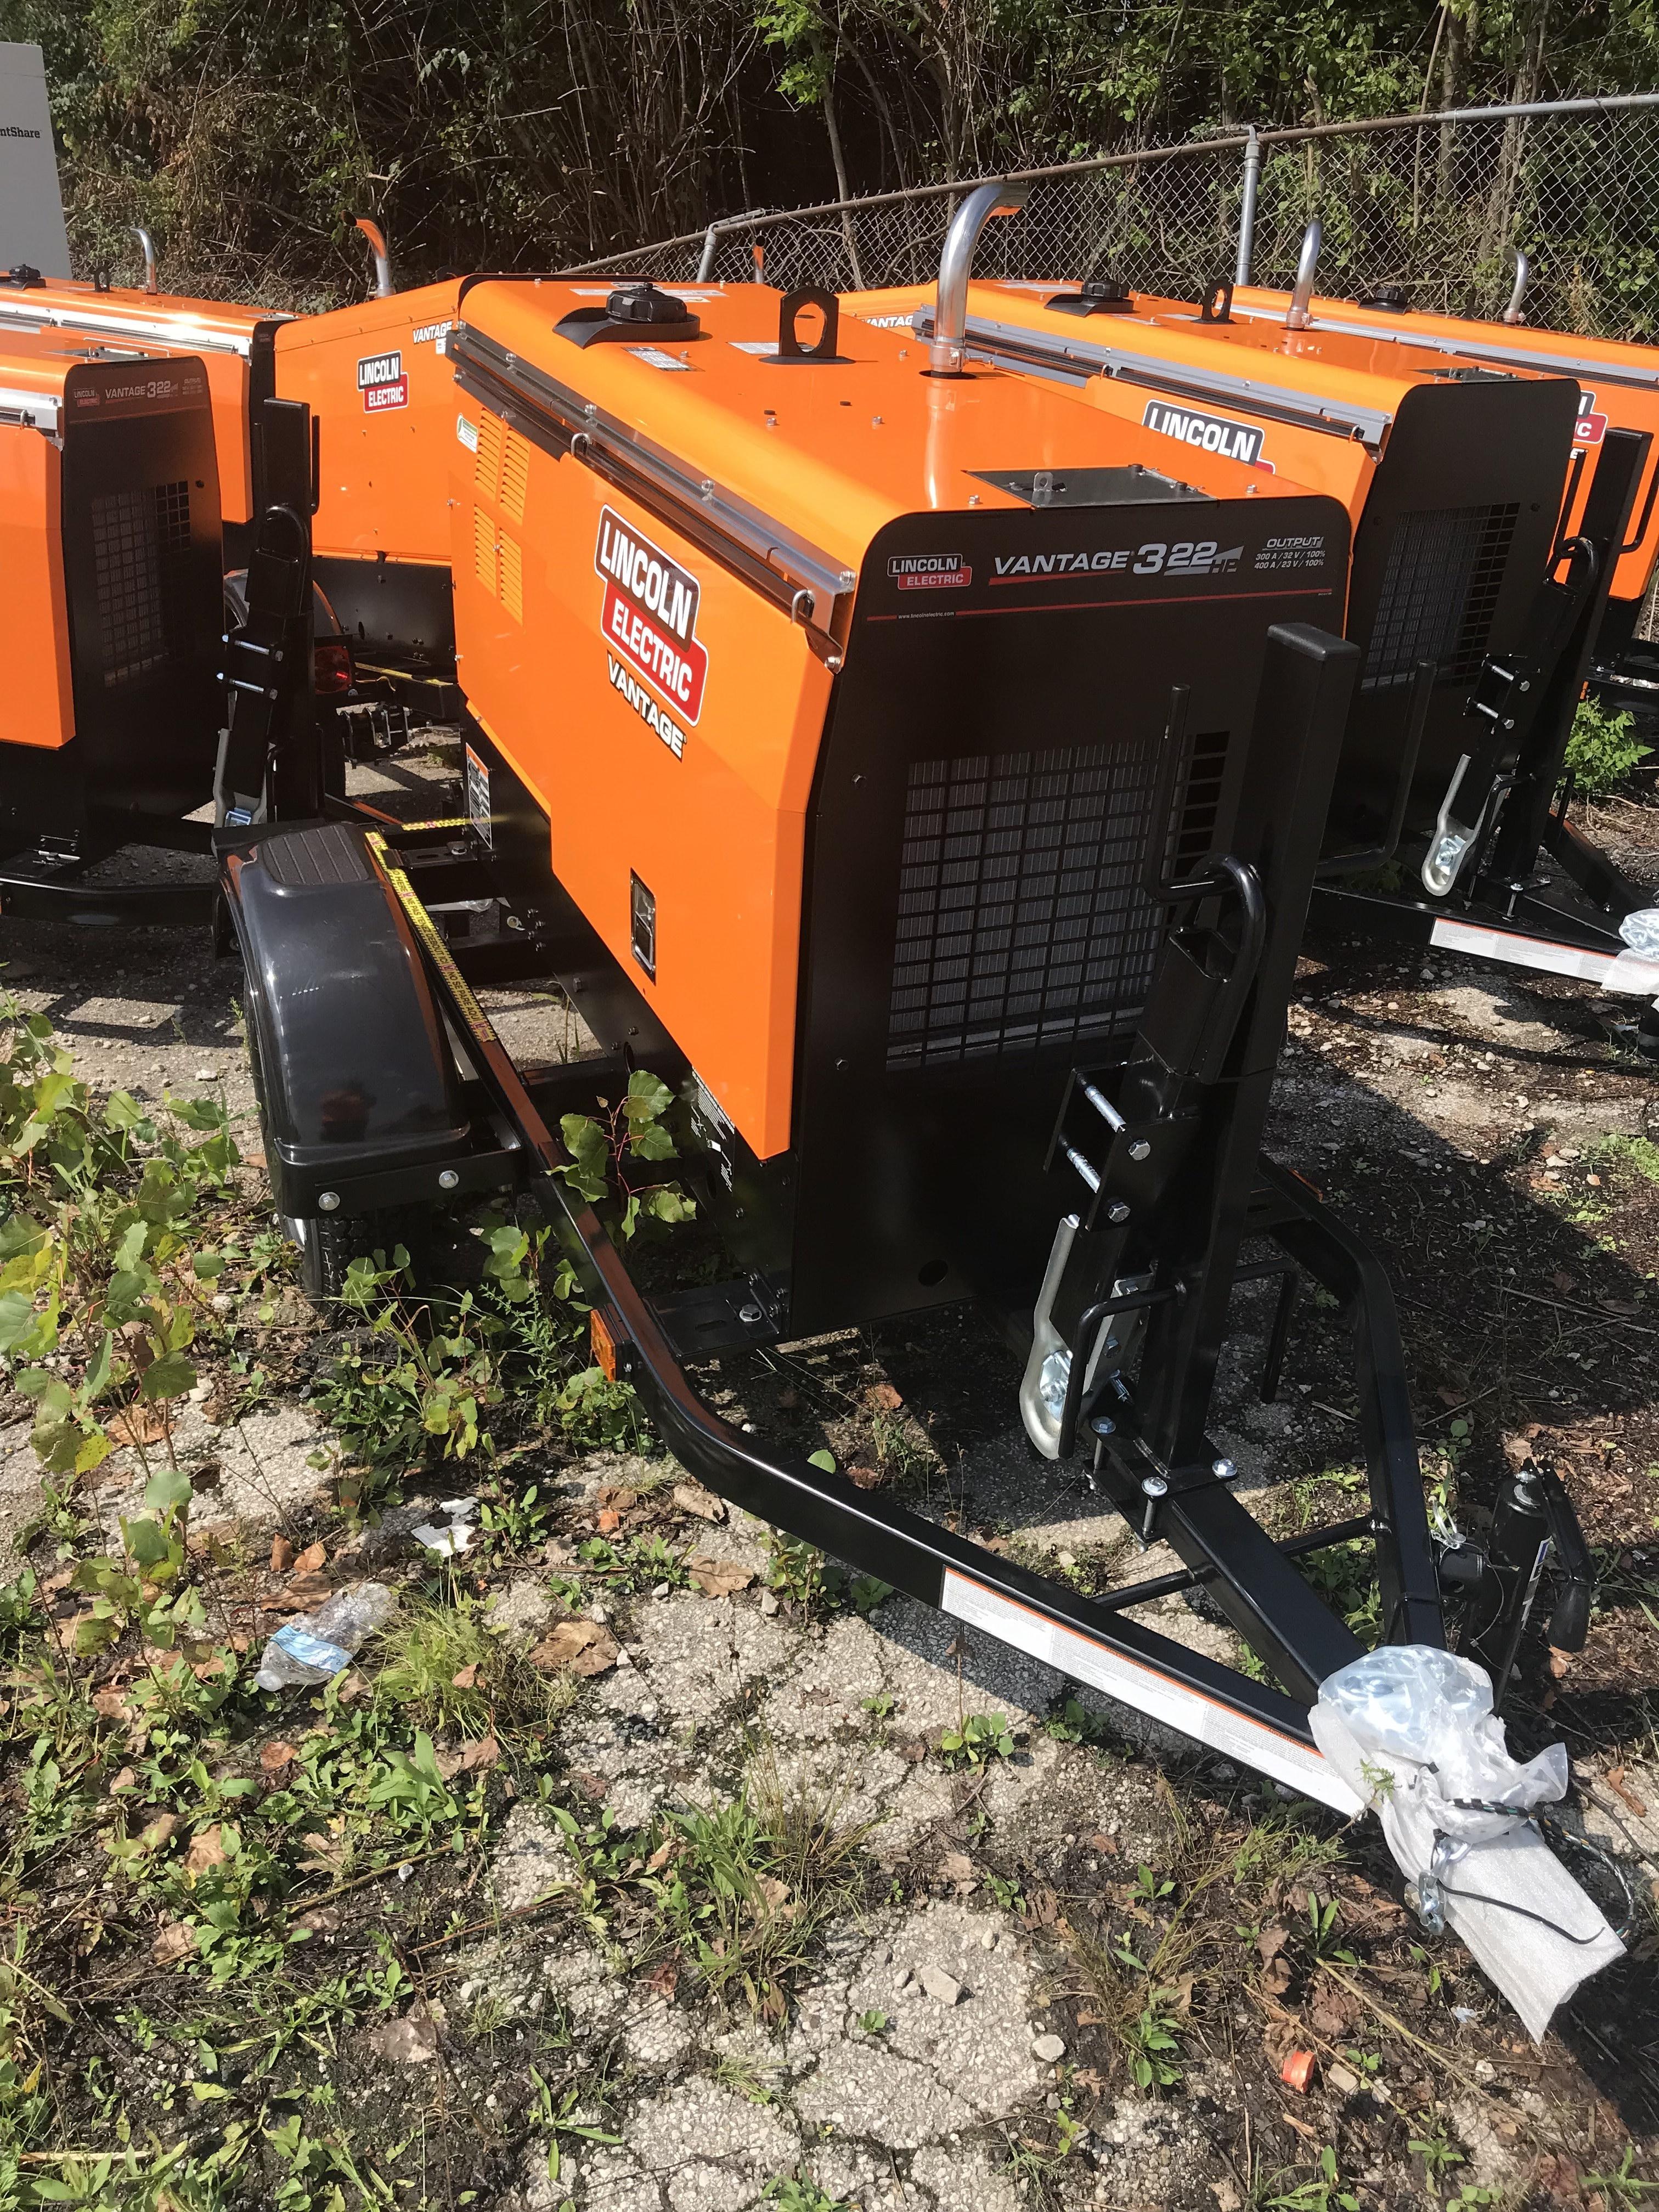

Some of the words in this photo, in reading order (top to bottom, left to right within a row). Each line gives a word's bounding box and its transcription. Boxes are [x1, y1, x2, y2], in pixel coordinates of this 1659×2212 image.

[0, 126, 41, 138] ntShare
[359, 357, 399, 386] LINCOLN
[105, 385, 146, 399] VANTAGE
[147, 380, 171, 398] 322
[368, 386, 404, 407] ELECTRIC
[1149, 408, 1256, 462] LINCOLN
[1266, 537, 1321, 548] OUTPUT
[892, 557, 958, 573] LINCOLN
[994, 551, 1131, 575] VANTAGE
[1132, 541, 1218, 574] 322
[1281, 560, 1291, 568] 23
[1305, 558, 1324, 567] 100%
[600, 520, 692, 640] LINCOLN
[906, 574, 964, 587] ELECTRIC
[611, 598, 692, 702] ELECTRIC
[607, 652, 685, 760] VANTAGE
[394, 876, 408, 892] HERE
[407, 898, 415, 907] NE
[411, 905, 422, 917] PAS
[417, 917, 432, 933] TENEZ
[426, 933, 445, 957] DEBOUT
[448, 971, 458, 981] NO
[453, 981, 464, 991] SE
[458, 990, 472, 1008] PARE
[466, 1006, 483, 1023] AQUI
